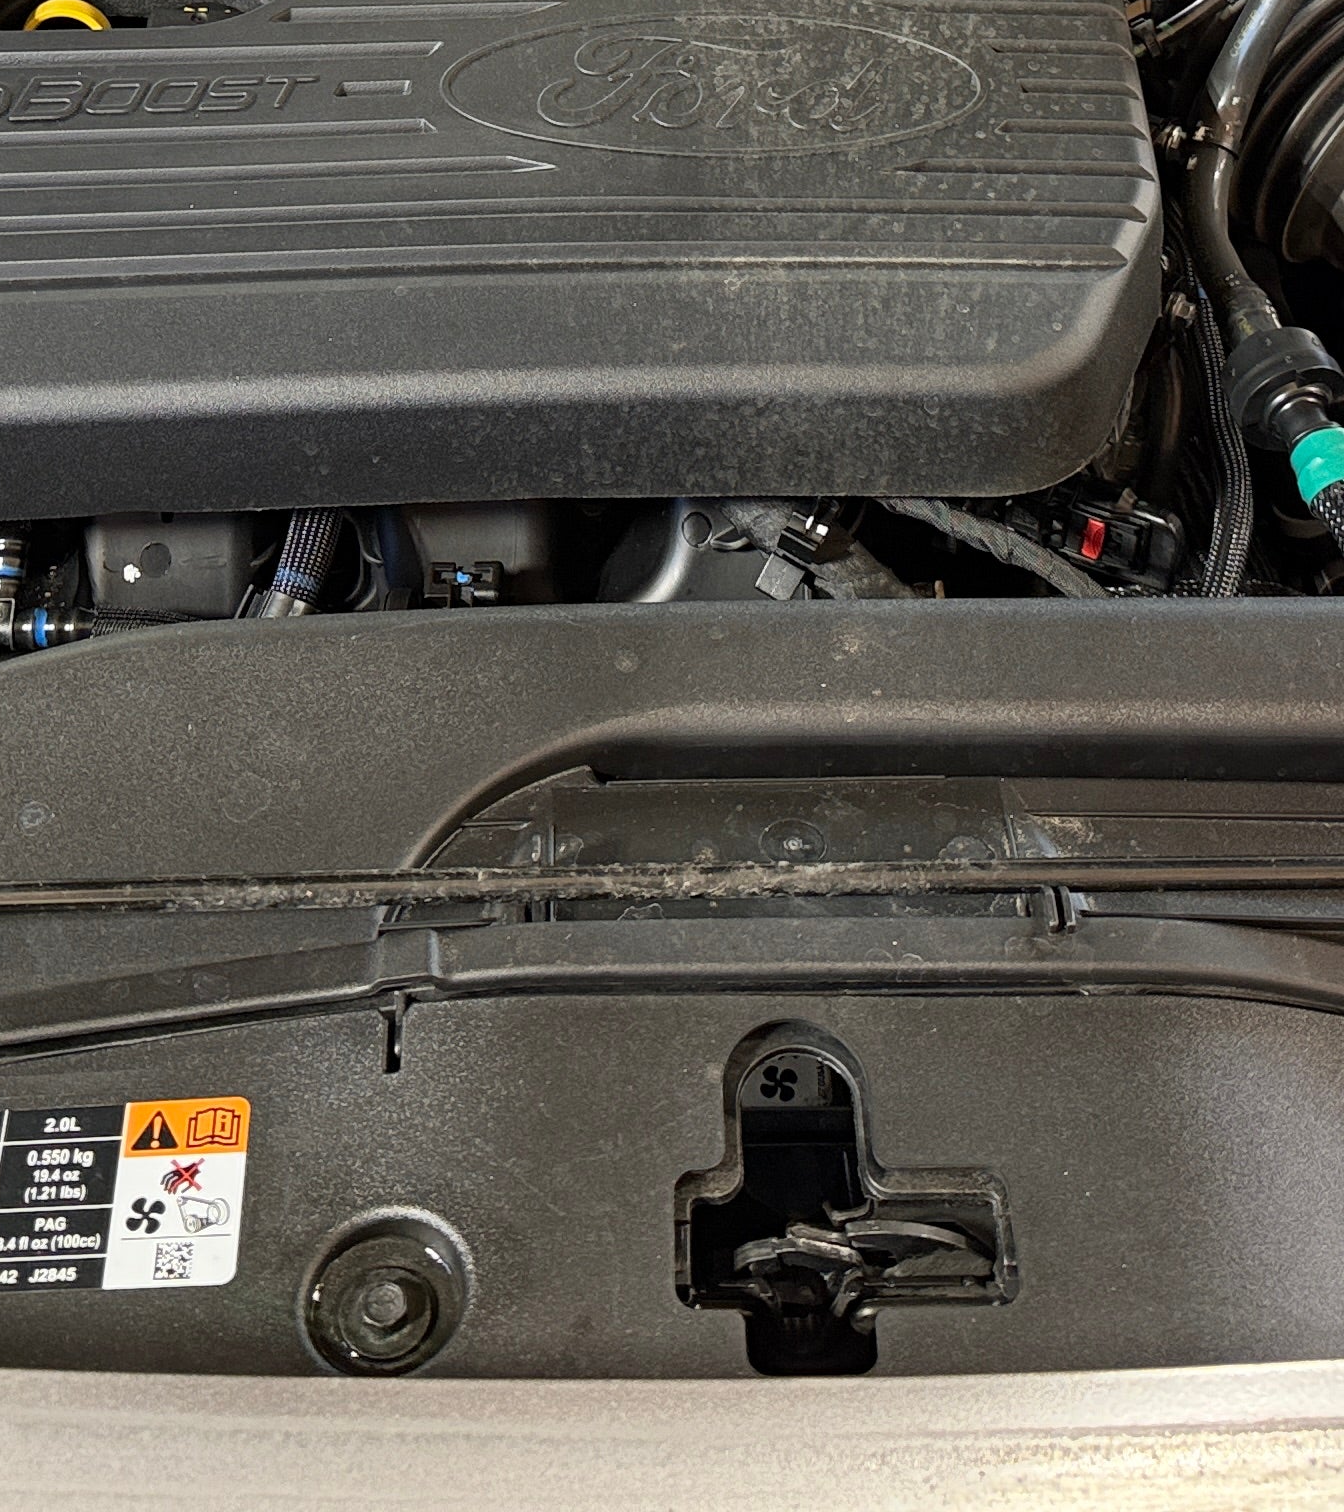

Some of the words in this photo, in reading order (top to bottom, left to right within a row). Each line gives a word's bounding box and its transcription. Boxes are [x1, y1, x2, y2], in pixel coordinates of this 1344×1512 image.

[43, 1117, 81, 1133] 2.0L
[27, 1149, 70, 1167] 0.550
[73, 1148, 94, 1167] kg
[33, 1169, 60, 1183] 19.4
[62, 1170, 81, 1182] oz
[24, 1187, 57, 1204] (1.21
[59, 1184, 87, 1201] lbs)
[34, 1216, 67, 1233] PAG
[31, 1238, 49, 1251] oz
[50, 1233, 101, 1252] (100cc)
[28, 1266, 78, 1284] J2845
